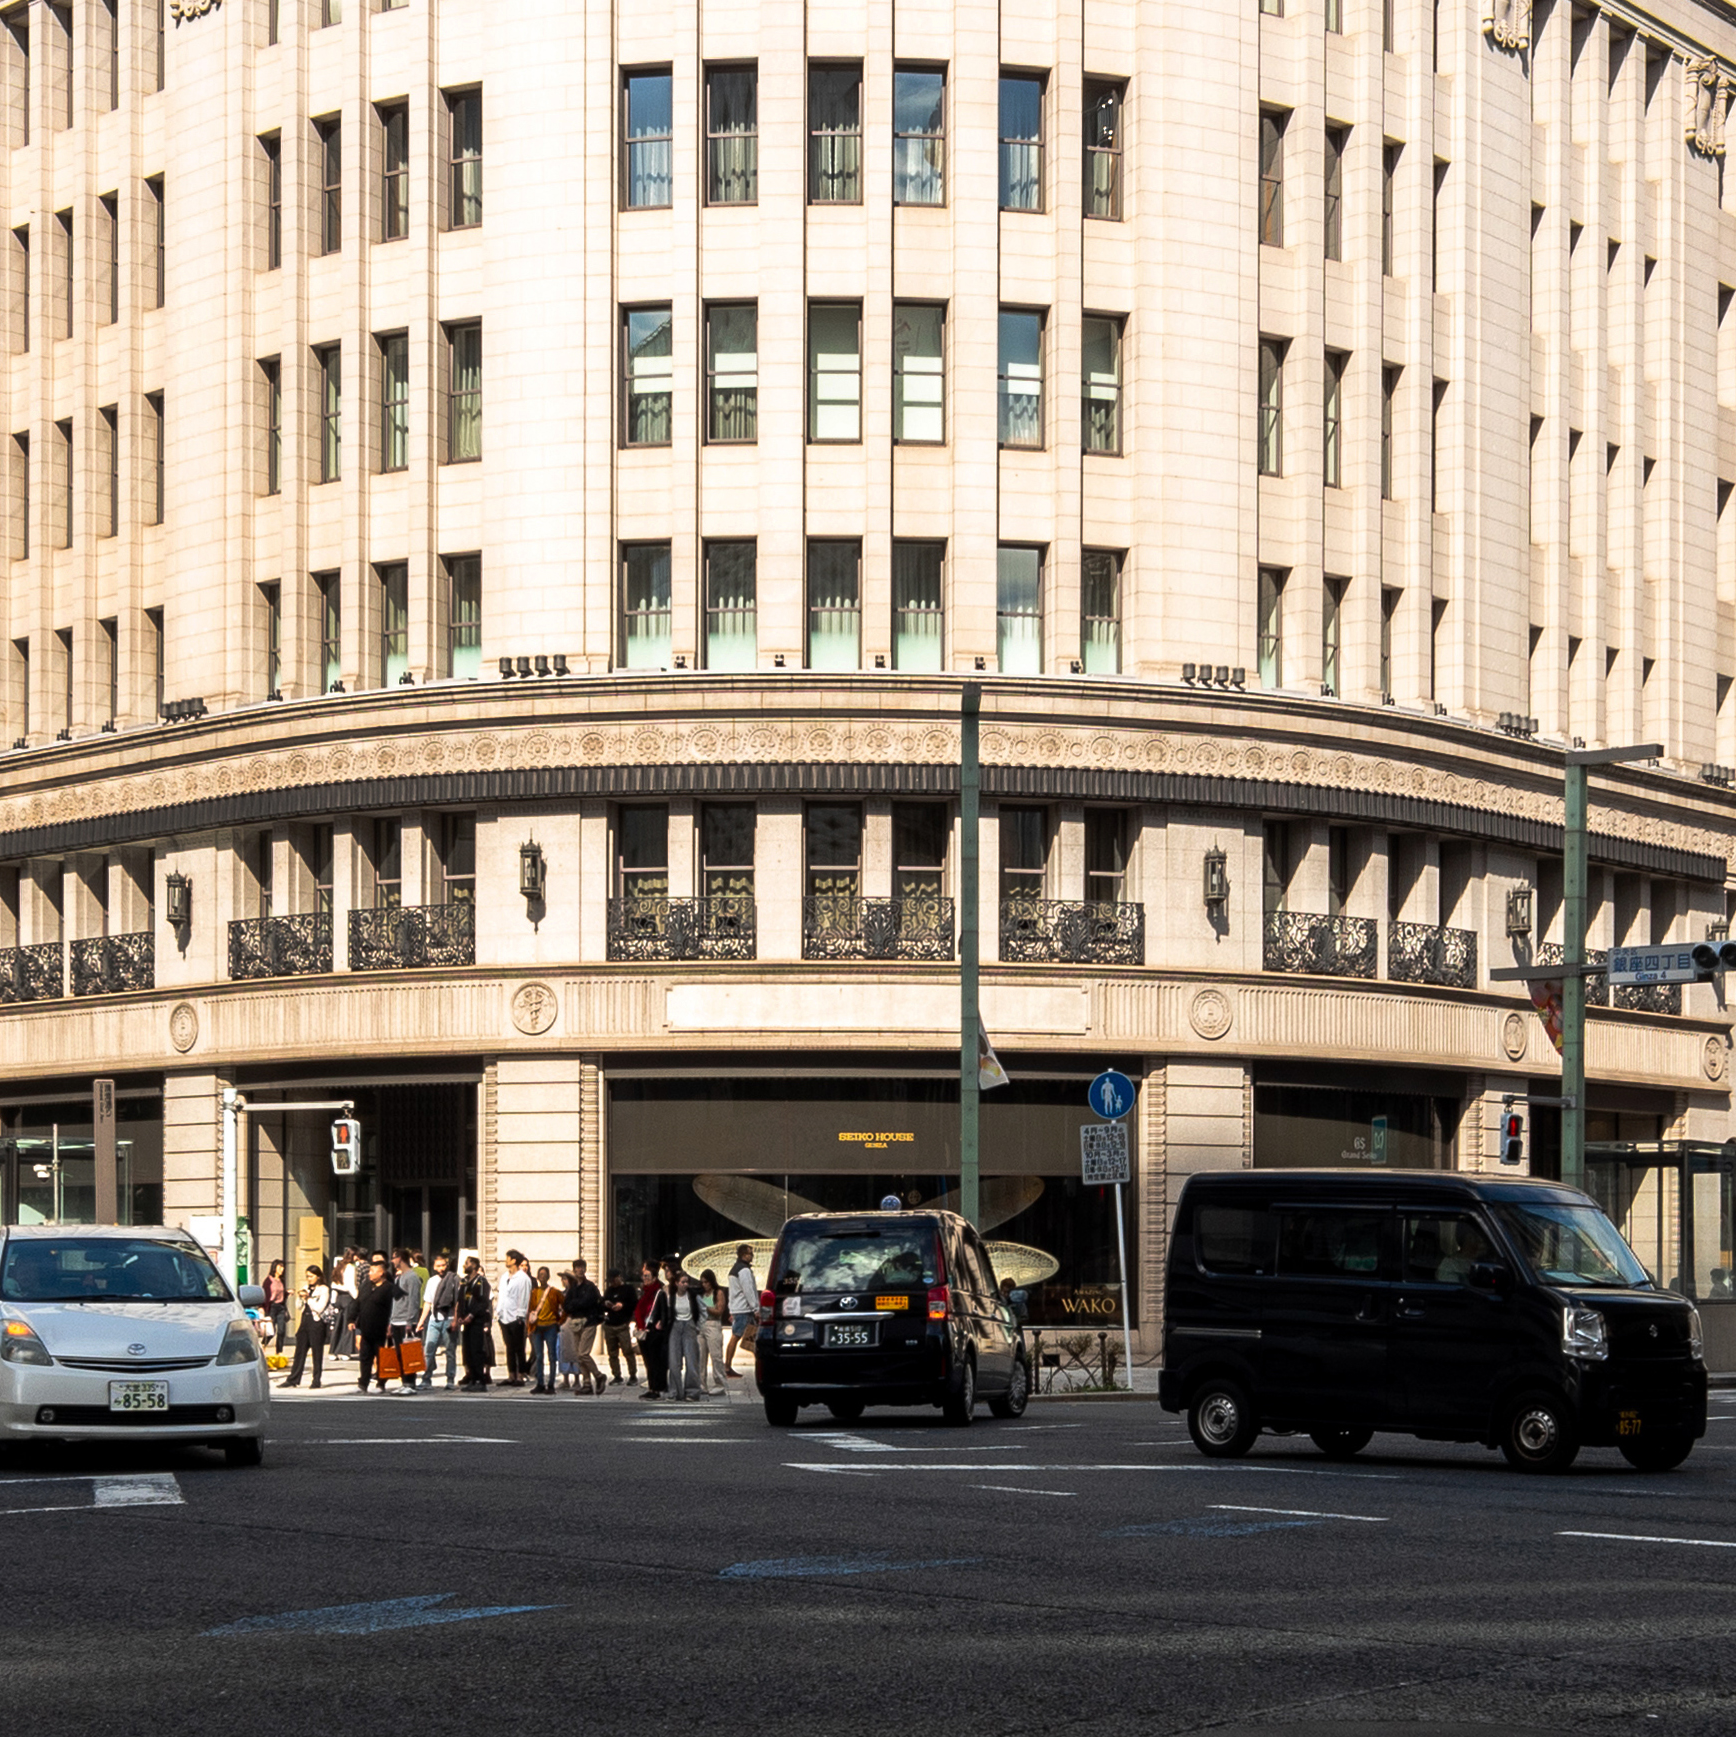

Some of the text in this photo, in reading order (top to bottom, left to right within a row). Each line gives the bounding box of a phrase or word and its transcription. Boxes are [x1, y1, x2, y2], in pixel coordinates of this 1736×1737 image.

[1613, 953, 1690, 972] 銀座四丁目
[1635, 971, 1666, 981] Ginza 4
[838, 1132, 914, 1142] SEIKO HOUSE
[1062, 1297, 1116, 1314] WAKO
[837, 1332, 868, 1344] 35-55
[123, 1393, 166, 1408] 85-58
